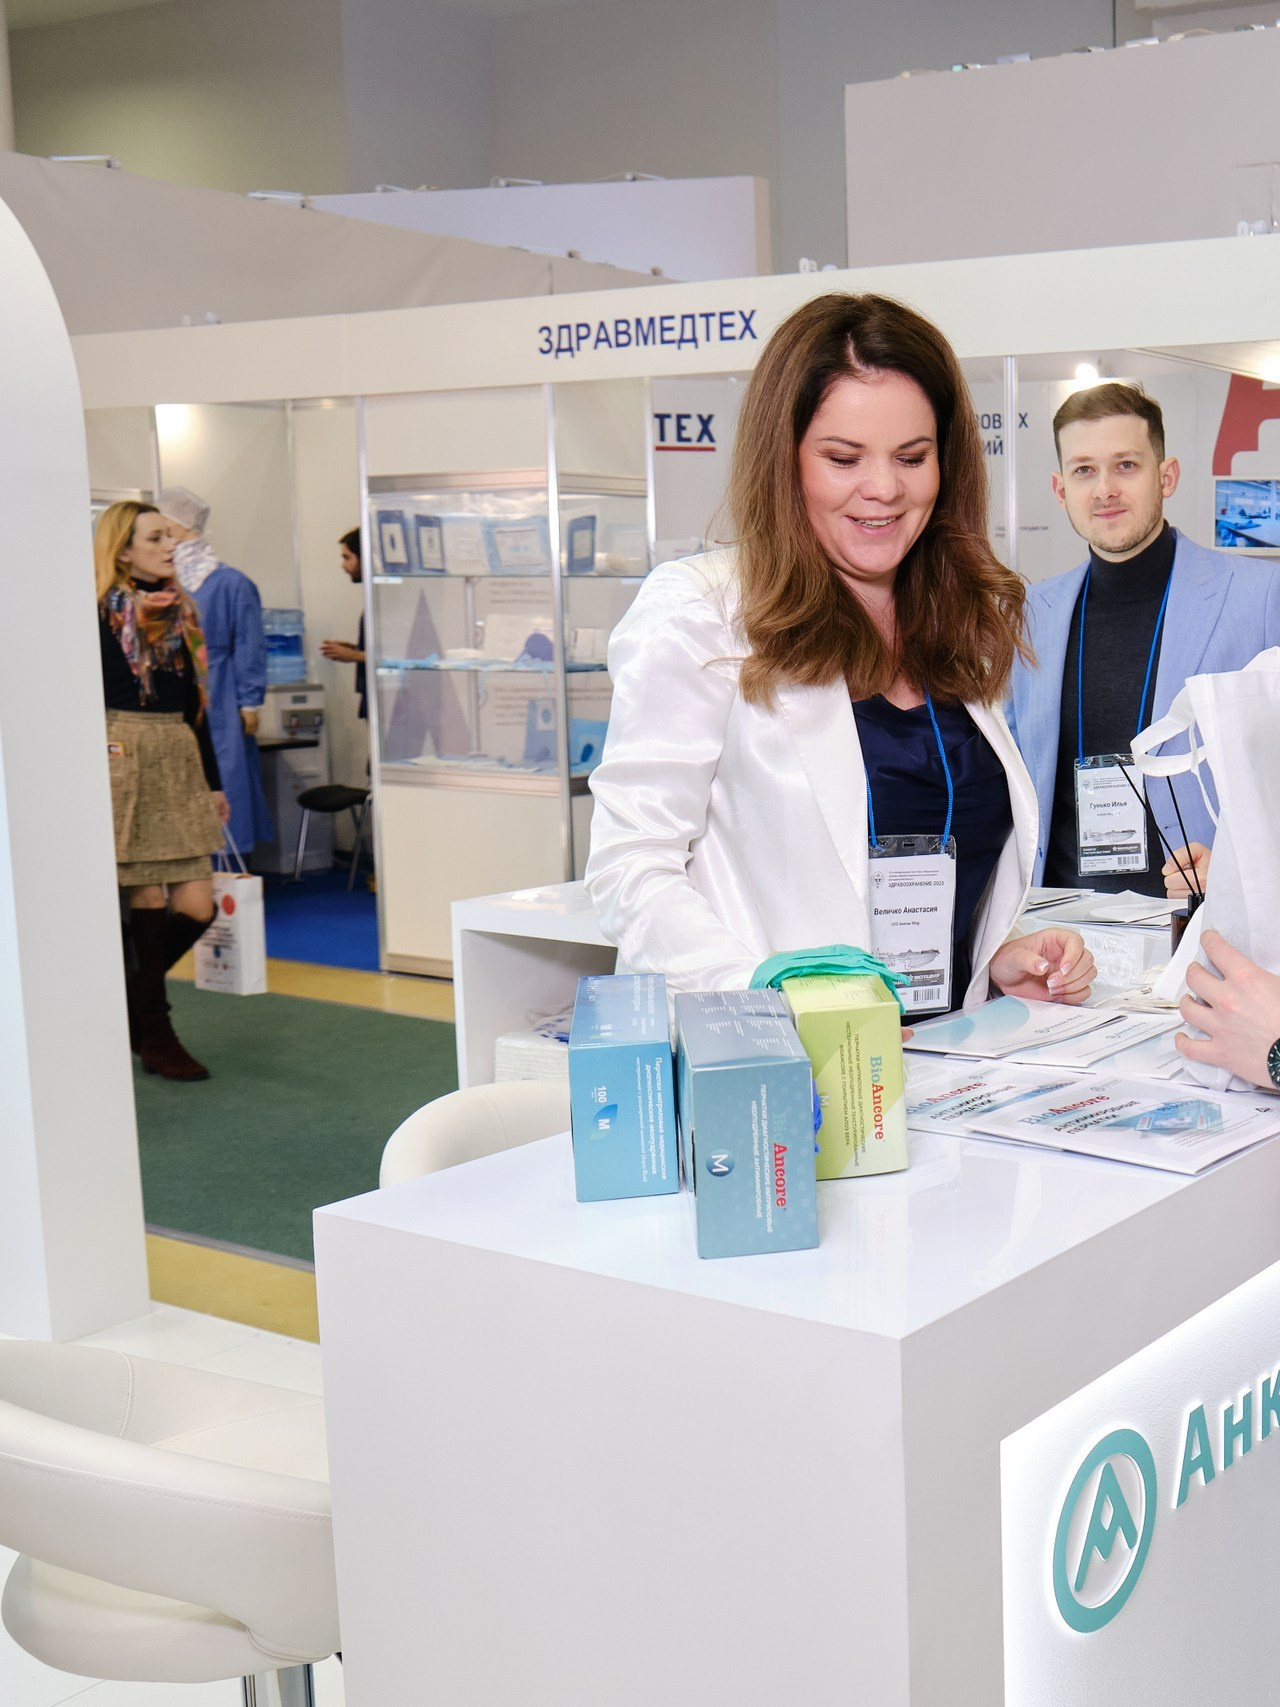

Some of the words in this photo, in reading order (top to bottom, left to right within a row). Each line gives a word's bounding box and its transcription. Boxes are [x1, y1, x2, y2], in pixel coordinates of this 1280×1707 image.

[538, 309, 757, 359] ЗДРАВМЕДТЕХ
[654, 412, 716, 443] ТЕХ
[1089, 802, 1110, 810] Гунько
[874, 907, 902, 916] Величко
[903, 906, 938, 914] Анастасия
[654, 1057, 663, 1091] Перчатки
[597, 1085, 608, 1103] 100
[644, 1064, 654, 1123] диагностические
[760, 1084, 768, 1120] ПЕРЧАТКИ
[930, 1085, 1017, 1119] АНТИМИКРОБНЫЕ
[942, 1099, 995, 1121] ПЕРЧАТКИ
[1017, 1095, 1110, 1125] BioAncore
[598, 1118, 610, 1130] M
[656, 1091, 664, 1133] нитриловые
[751, 1101, 760, 1157] НЕОПУДРЕННЫЕ
[1054, 1100, 1141, 1131] АНТИМИКРОБНЫЕ
[1066, 1114, 1120, 1135] ПЕРЧАТКИ
[648, 1124, 657, 1175] неопудренные
[659, 1134, 667, 1180] медицинские
[711, 1153, 729, 1173] M
[761, 1119, 770, 1185] ДИАГНОСТИЧЕСКИЕ
[754, 1157, 763, 1219] АНТИМИКРОБНЫЕ
[766, 1186, 774, 1233] НИТРИЛОВЫЕ
